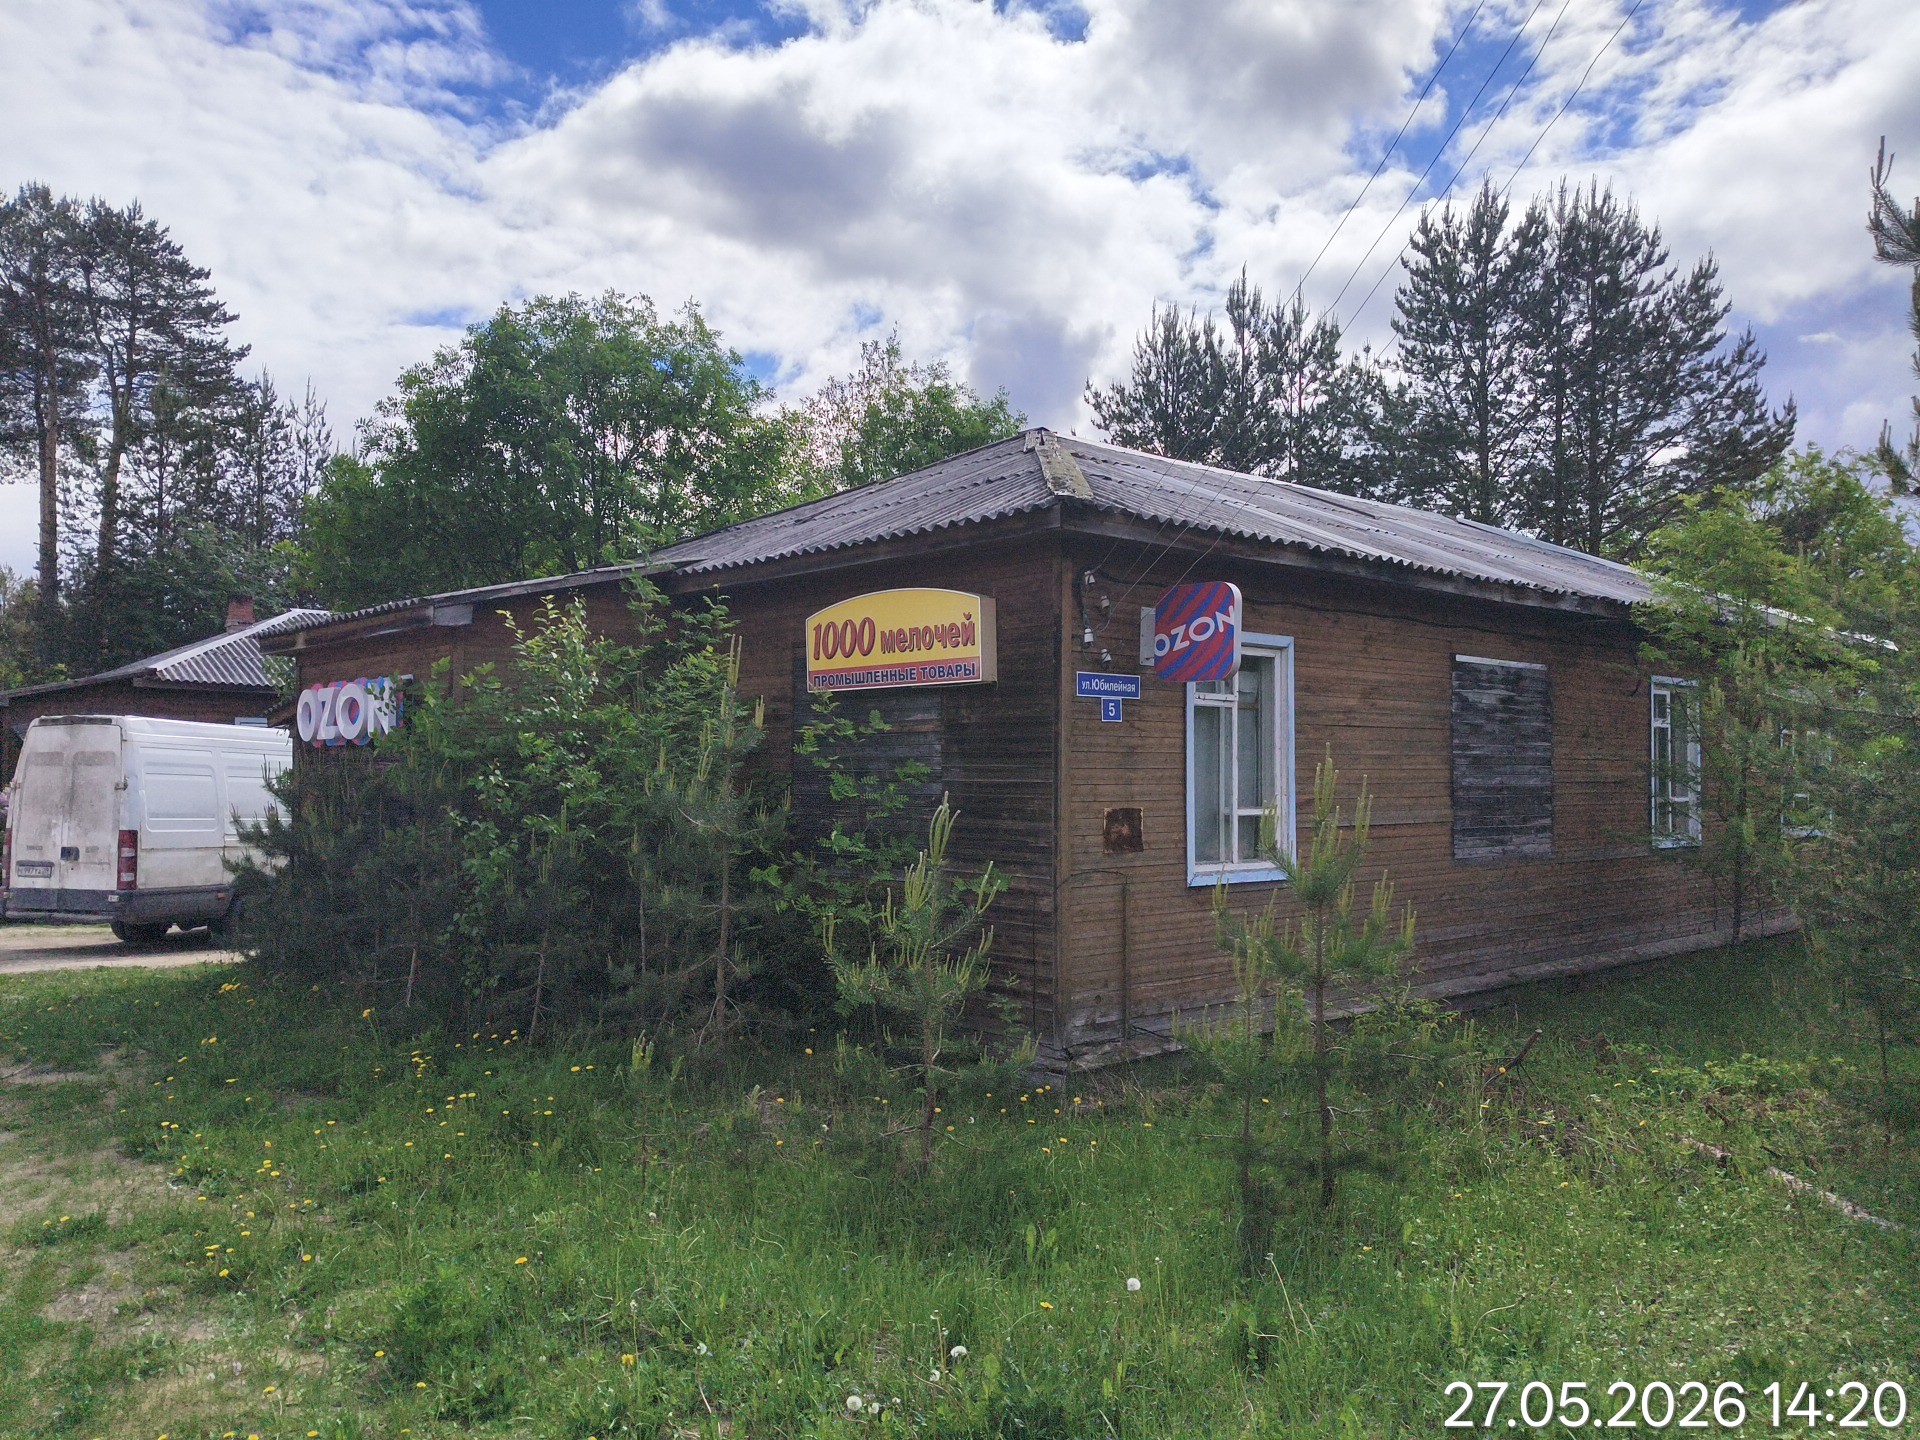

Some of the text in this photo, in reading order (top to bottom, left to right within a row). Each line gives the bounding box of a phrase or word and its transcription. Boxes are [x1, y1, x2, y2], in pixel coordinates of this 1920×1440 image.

[813, 612, 976, 660] 1000 мелочей
[1154, 605, 1234, 657] OZON
[813, 662, 976, 688] ПРОМЫШЛЕННЫЕ ТОВАРЫ
[1081, 678, 1136, 693] ул.Юбилейная
[297, 677, 393, 741] OZON
[1108, 702, 1116, 717] 5
